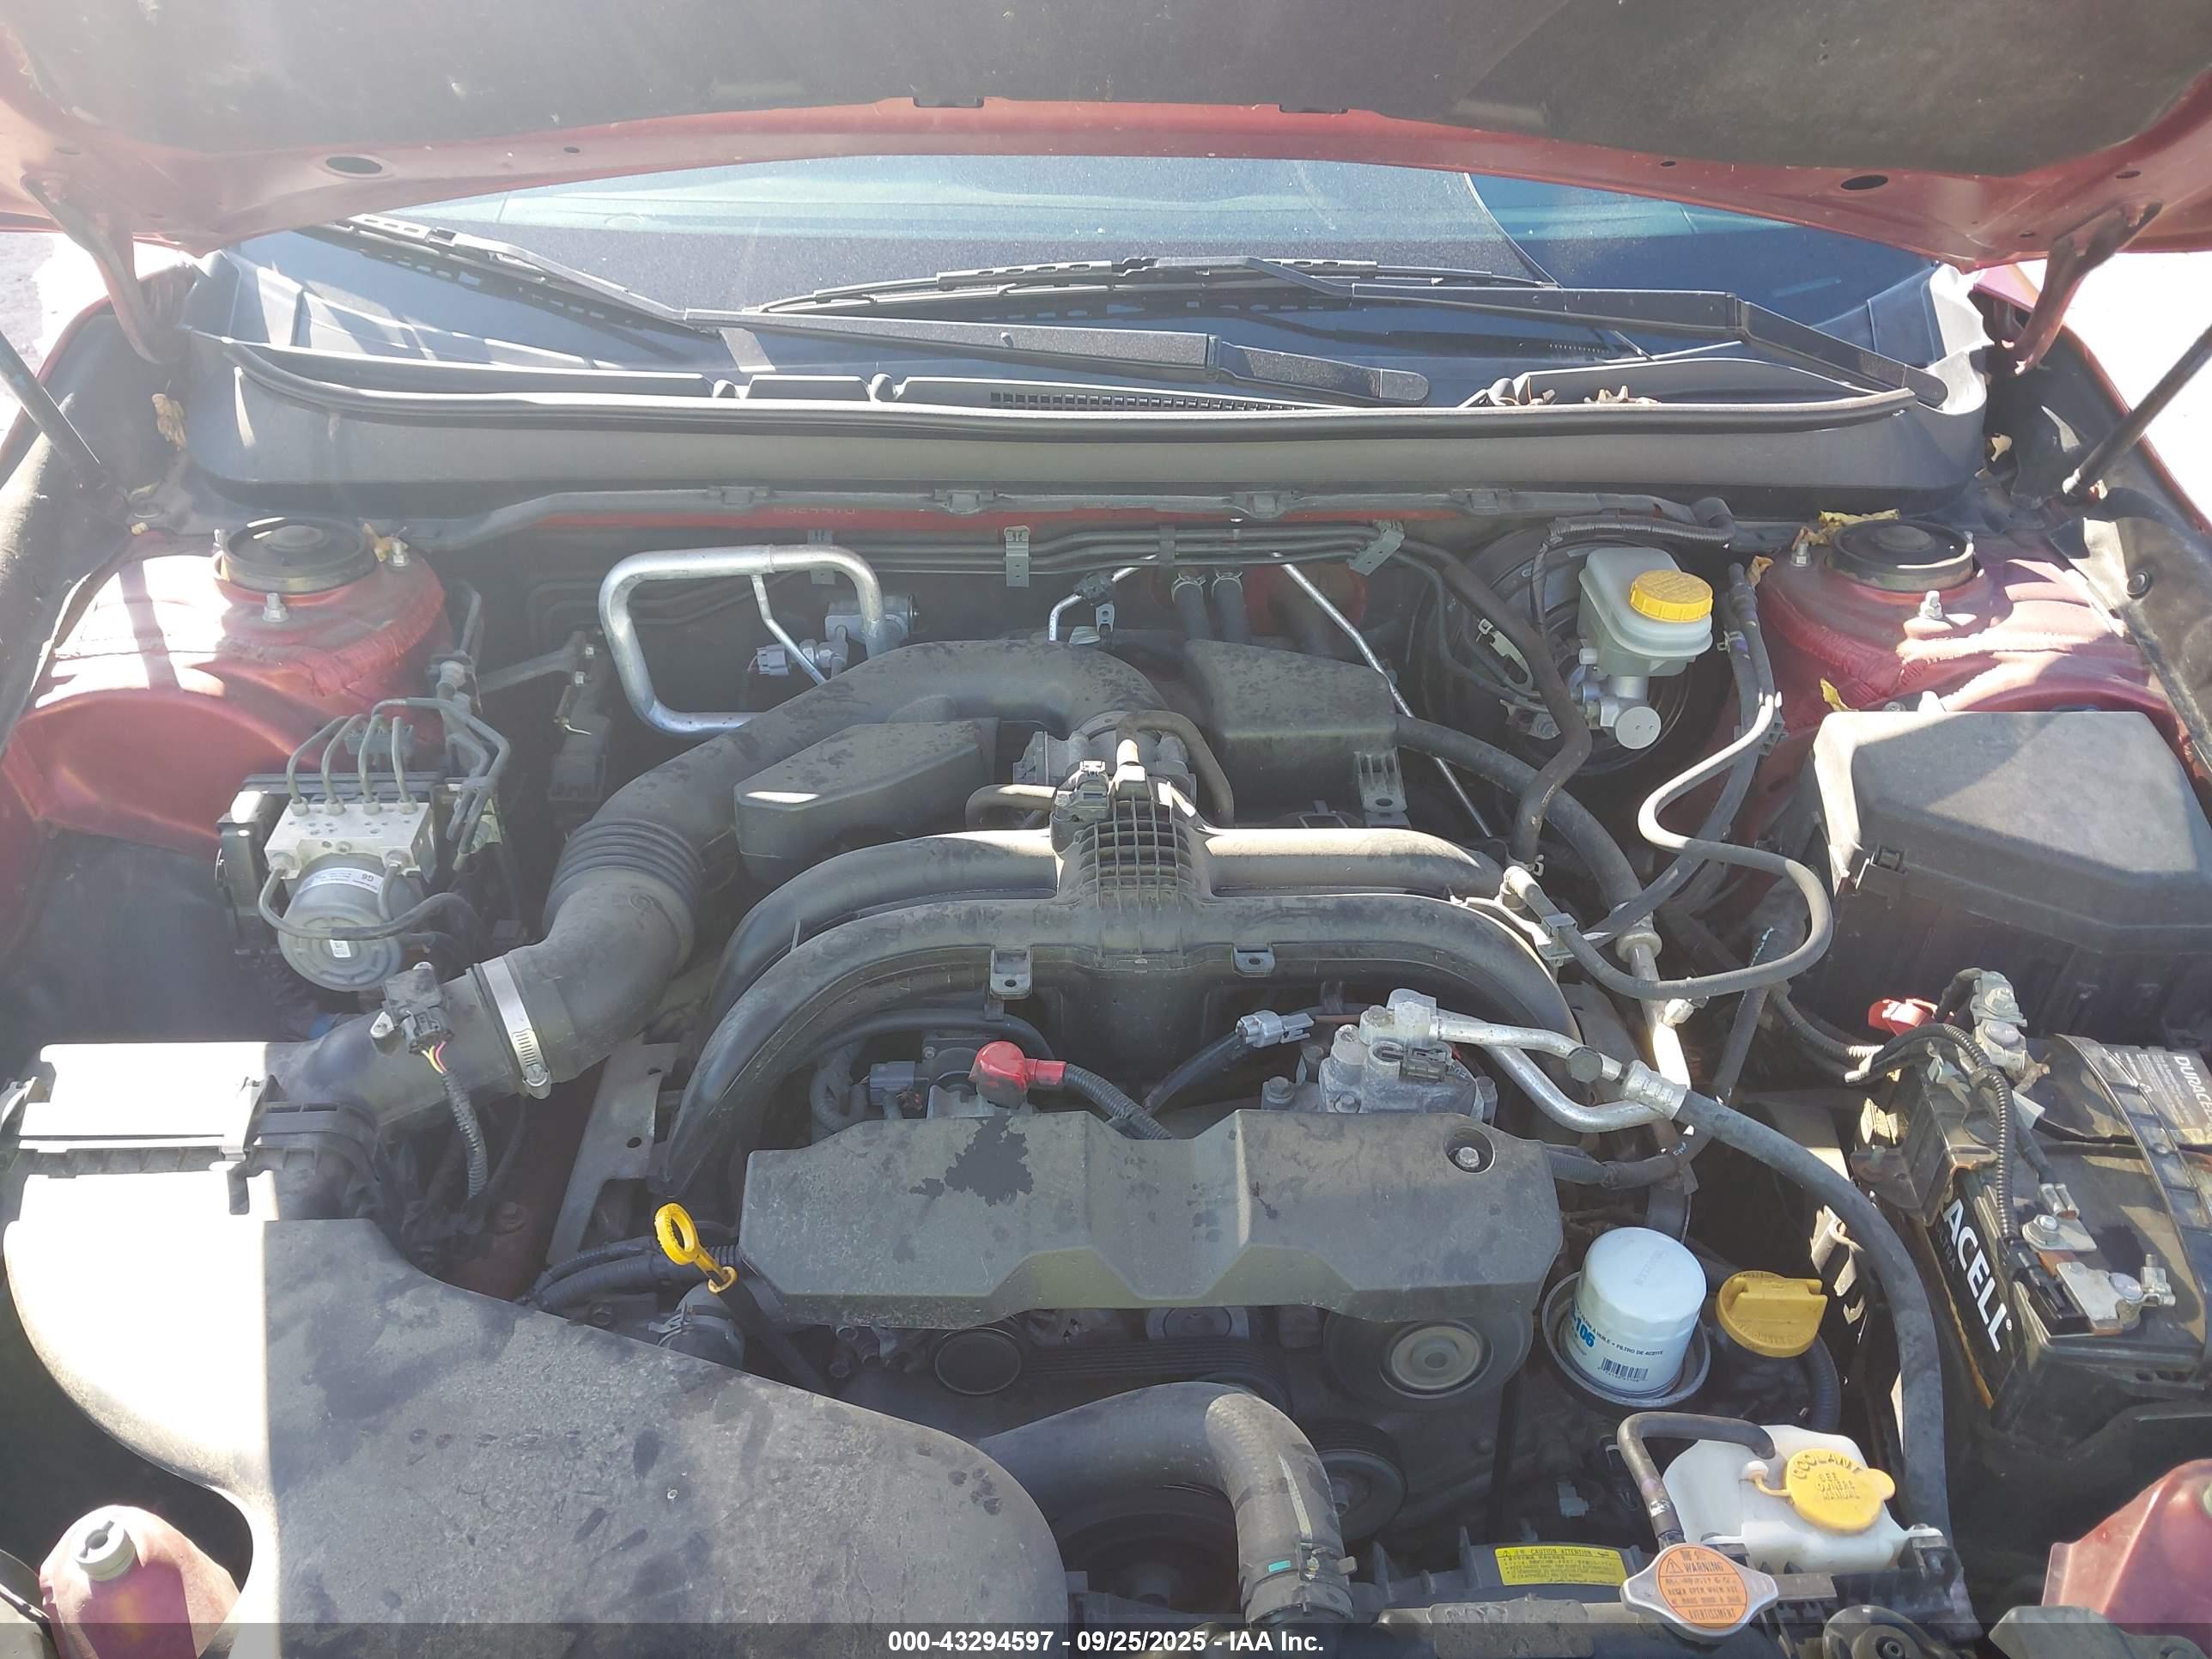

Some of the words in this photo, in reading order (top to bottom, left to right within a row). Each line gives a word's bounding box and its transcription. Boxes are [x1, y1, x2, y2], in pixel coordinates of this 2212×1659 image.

[1942, 1198, 2008, 1353] ACELL
[1616, 1344, 1635, 1354] FILTRO
[1792, 1453, 1862, 1480] COOLANT
[1561, 1548, 1593, 1557] ATTENTION
[1684, 1560, 1725, 1573] WARNING
